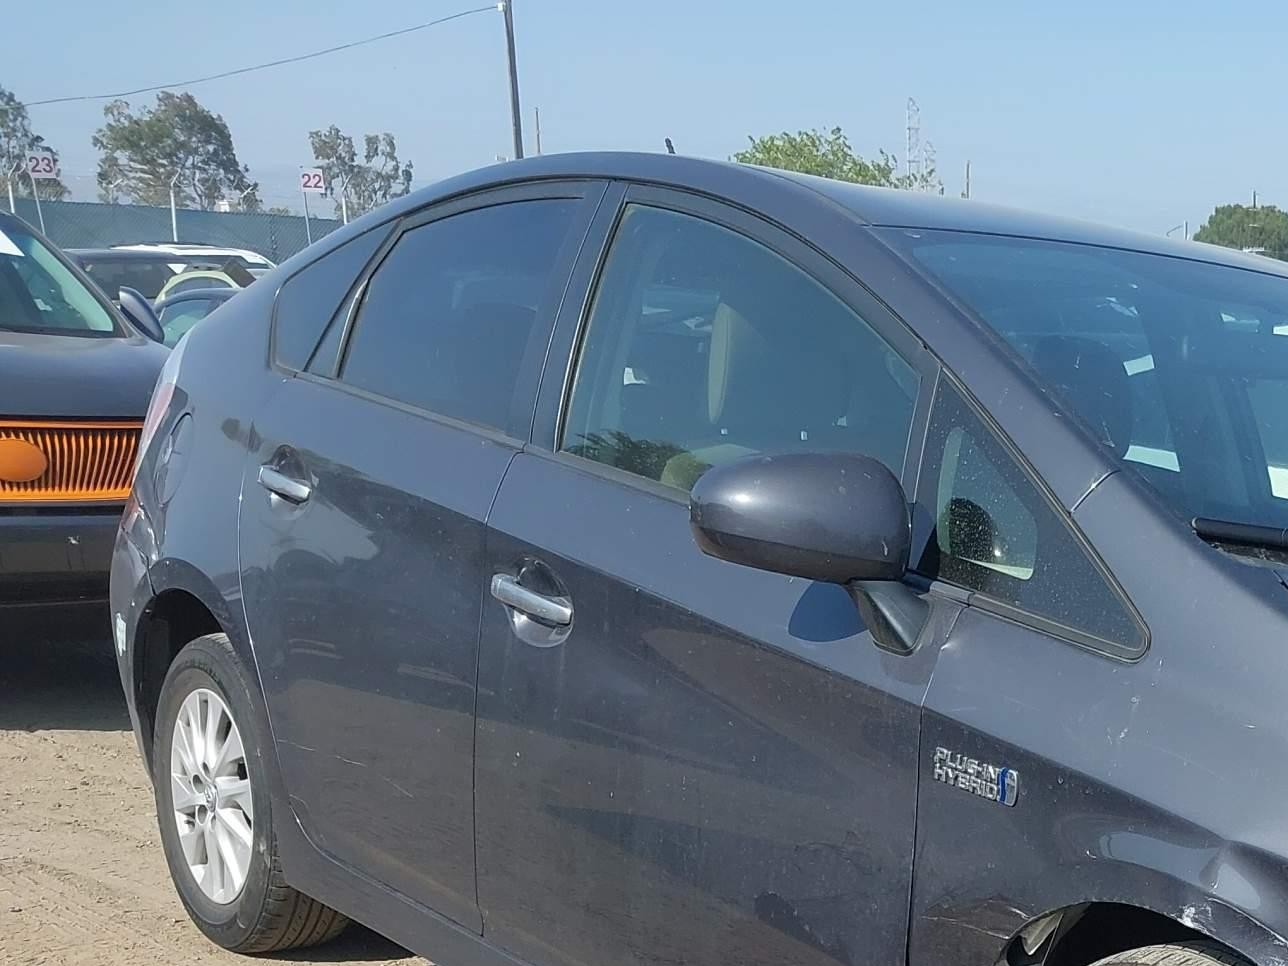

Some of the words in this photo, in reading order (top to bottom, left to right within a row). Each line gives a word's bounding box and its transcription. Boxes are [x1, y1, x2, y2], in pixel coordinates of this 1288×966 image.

[28, 156, 53, 173] 23
[301, 173, 323, 188] 22
[933, 746, 1000, 783] PLUG-IN
[933, 763, 997, 801] HYBRID
